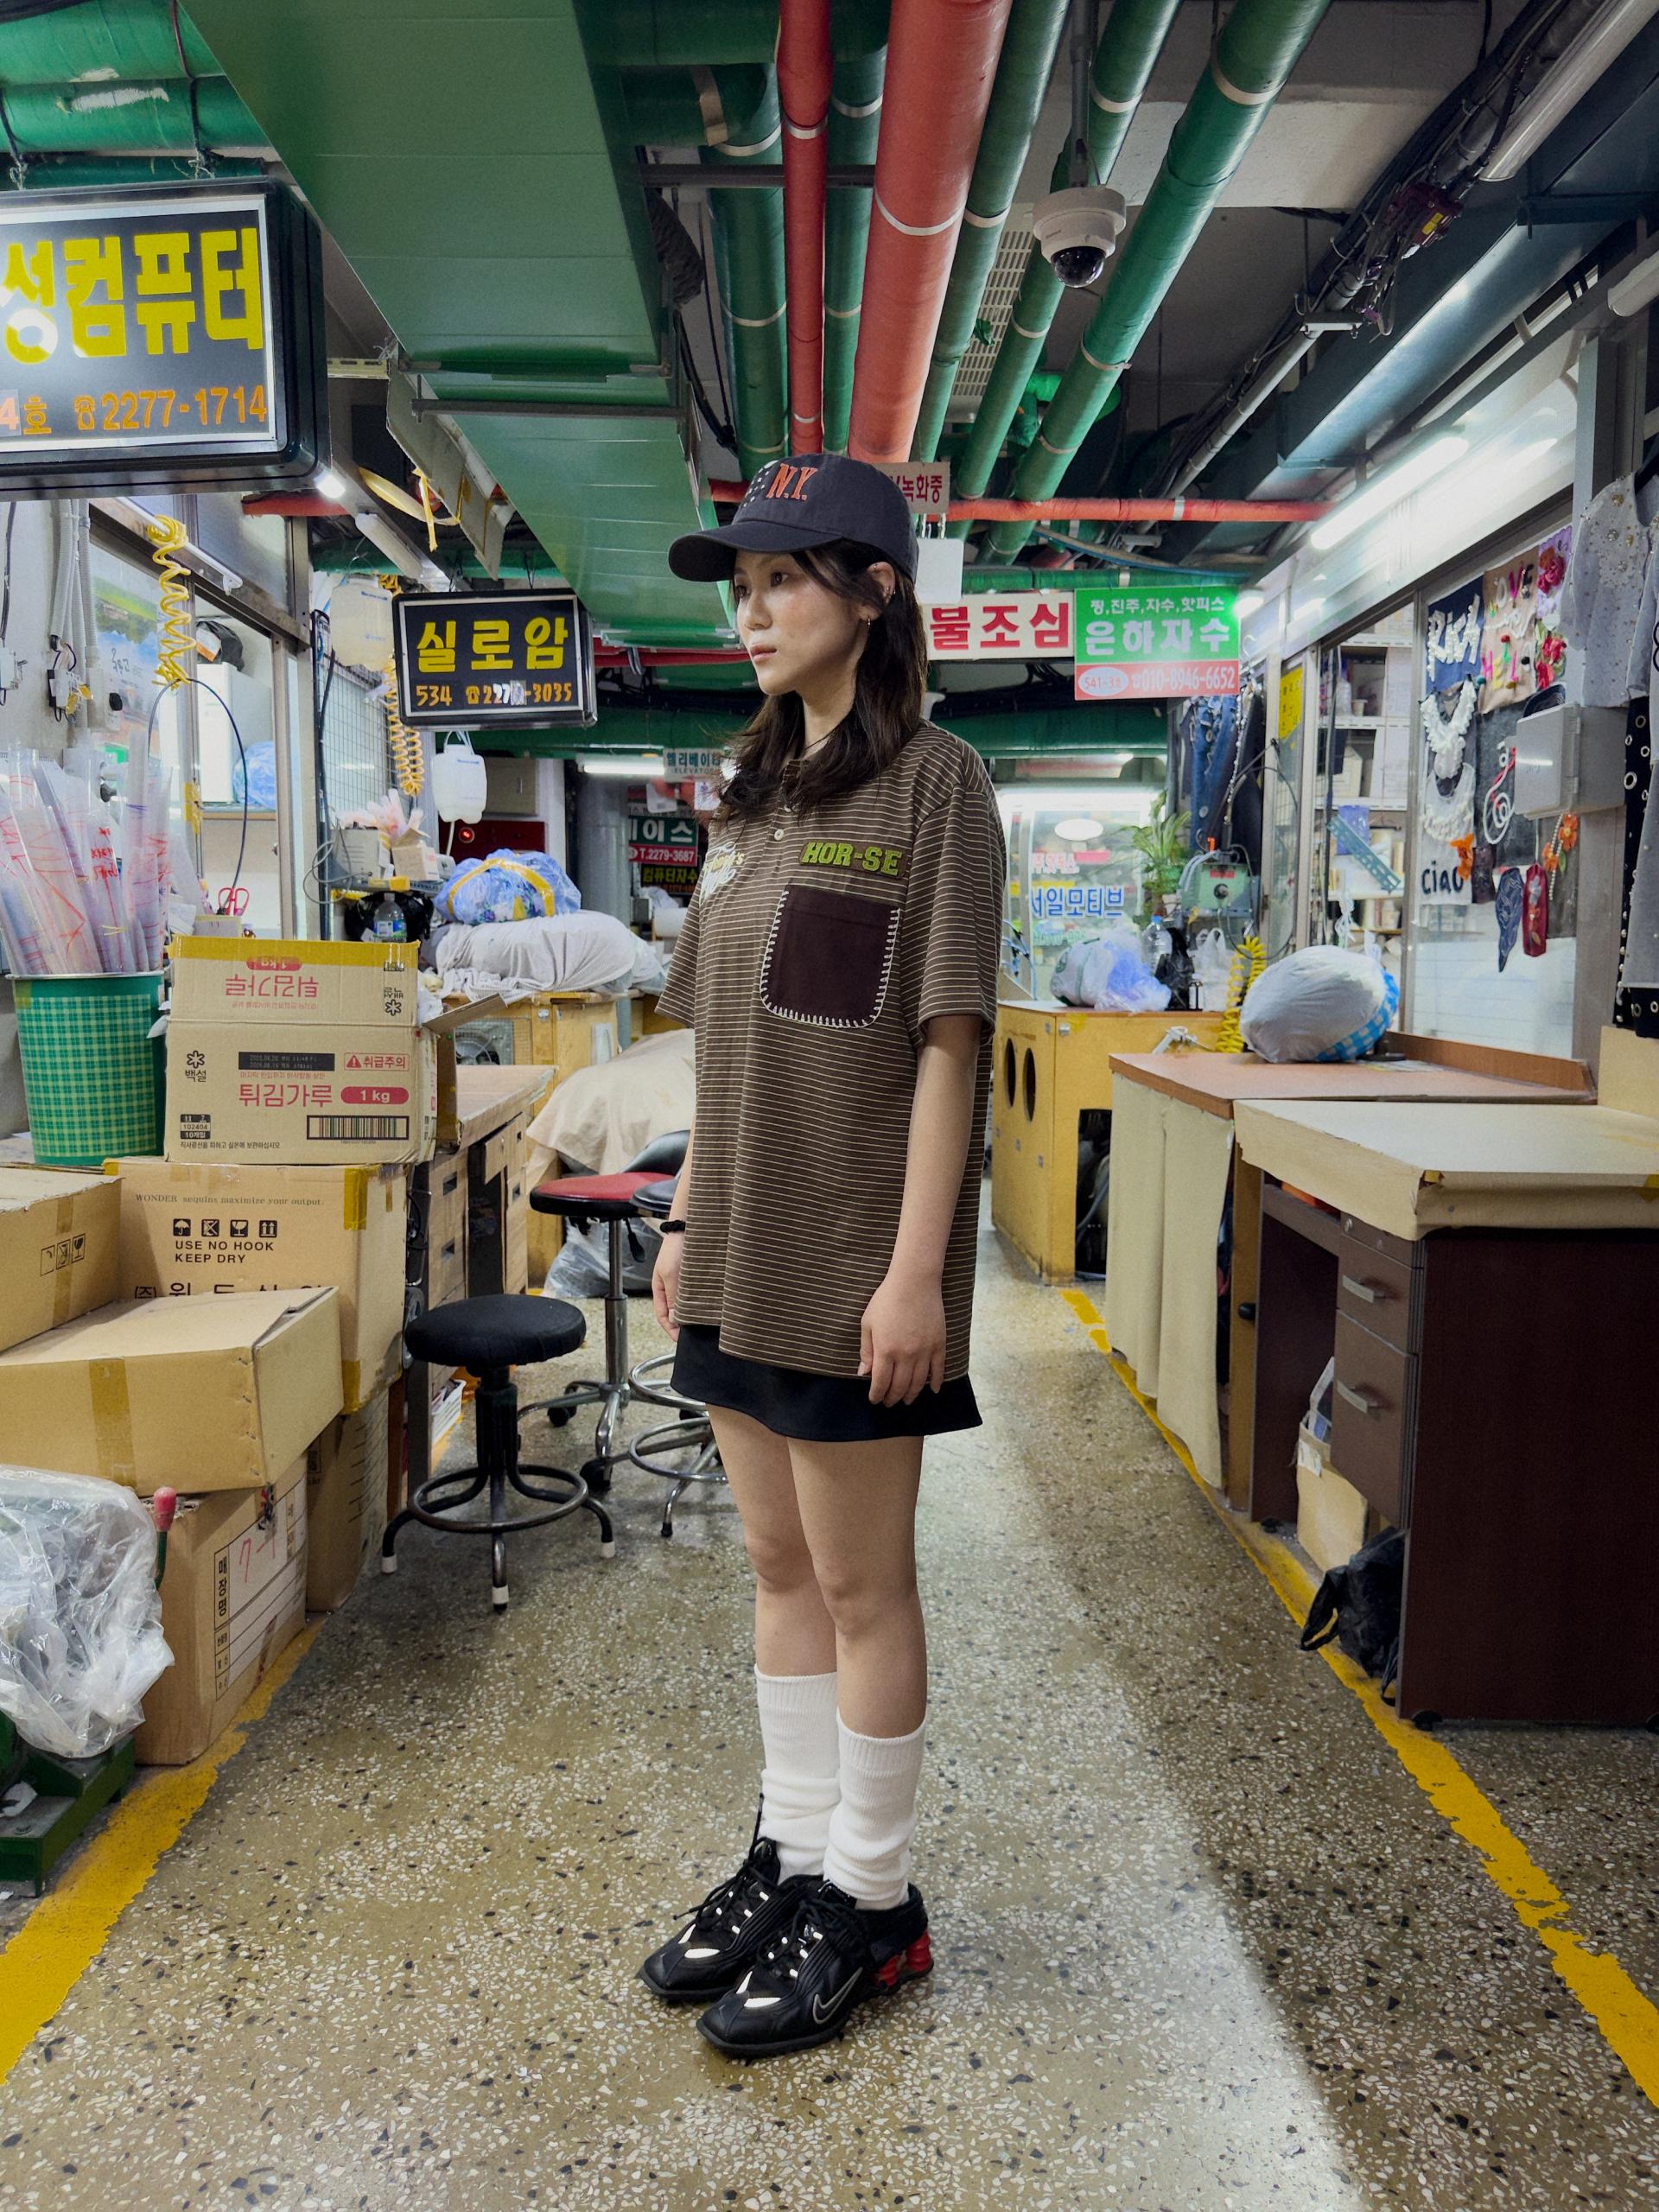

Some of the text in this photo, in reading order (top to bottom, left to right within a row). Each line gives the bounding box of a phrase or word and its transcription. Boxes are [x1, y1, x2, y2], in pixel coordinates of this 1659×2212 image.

[1, 227, 264, 365] 성컴퓨터
[102, 385, 267, 430] 2277-1714
[930, 602, 1069, 651] 불조심
[1085, 618, 1230, 656] 은하자수
[416, 617, 569, 673] 실로암
[416, 681, 572, 706] 534 227-3035
[801, 842, 902, 876] HOR-SE
[226, 974, 319, 997] 튀김가루
[363, 1056, 405, 1069] 취급주의
[185, 1069, 207, 1082] 백설
[238, 1084, 333, 1108] 튀김가루
[360, 1090, 391, 1103] 1 kg
[135, 1194, 178, 1203] WONDER
[221, 1197, 265, 1205] maximize
[267, 1198, 288, 1206] your
[175, 1241, 274, 1251] USE NO HOOK
[175, 1254, 245, 1263] KEEP DRY
